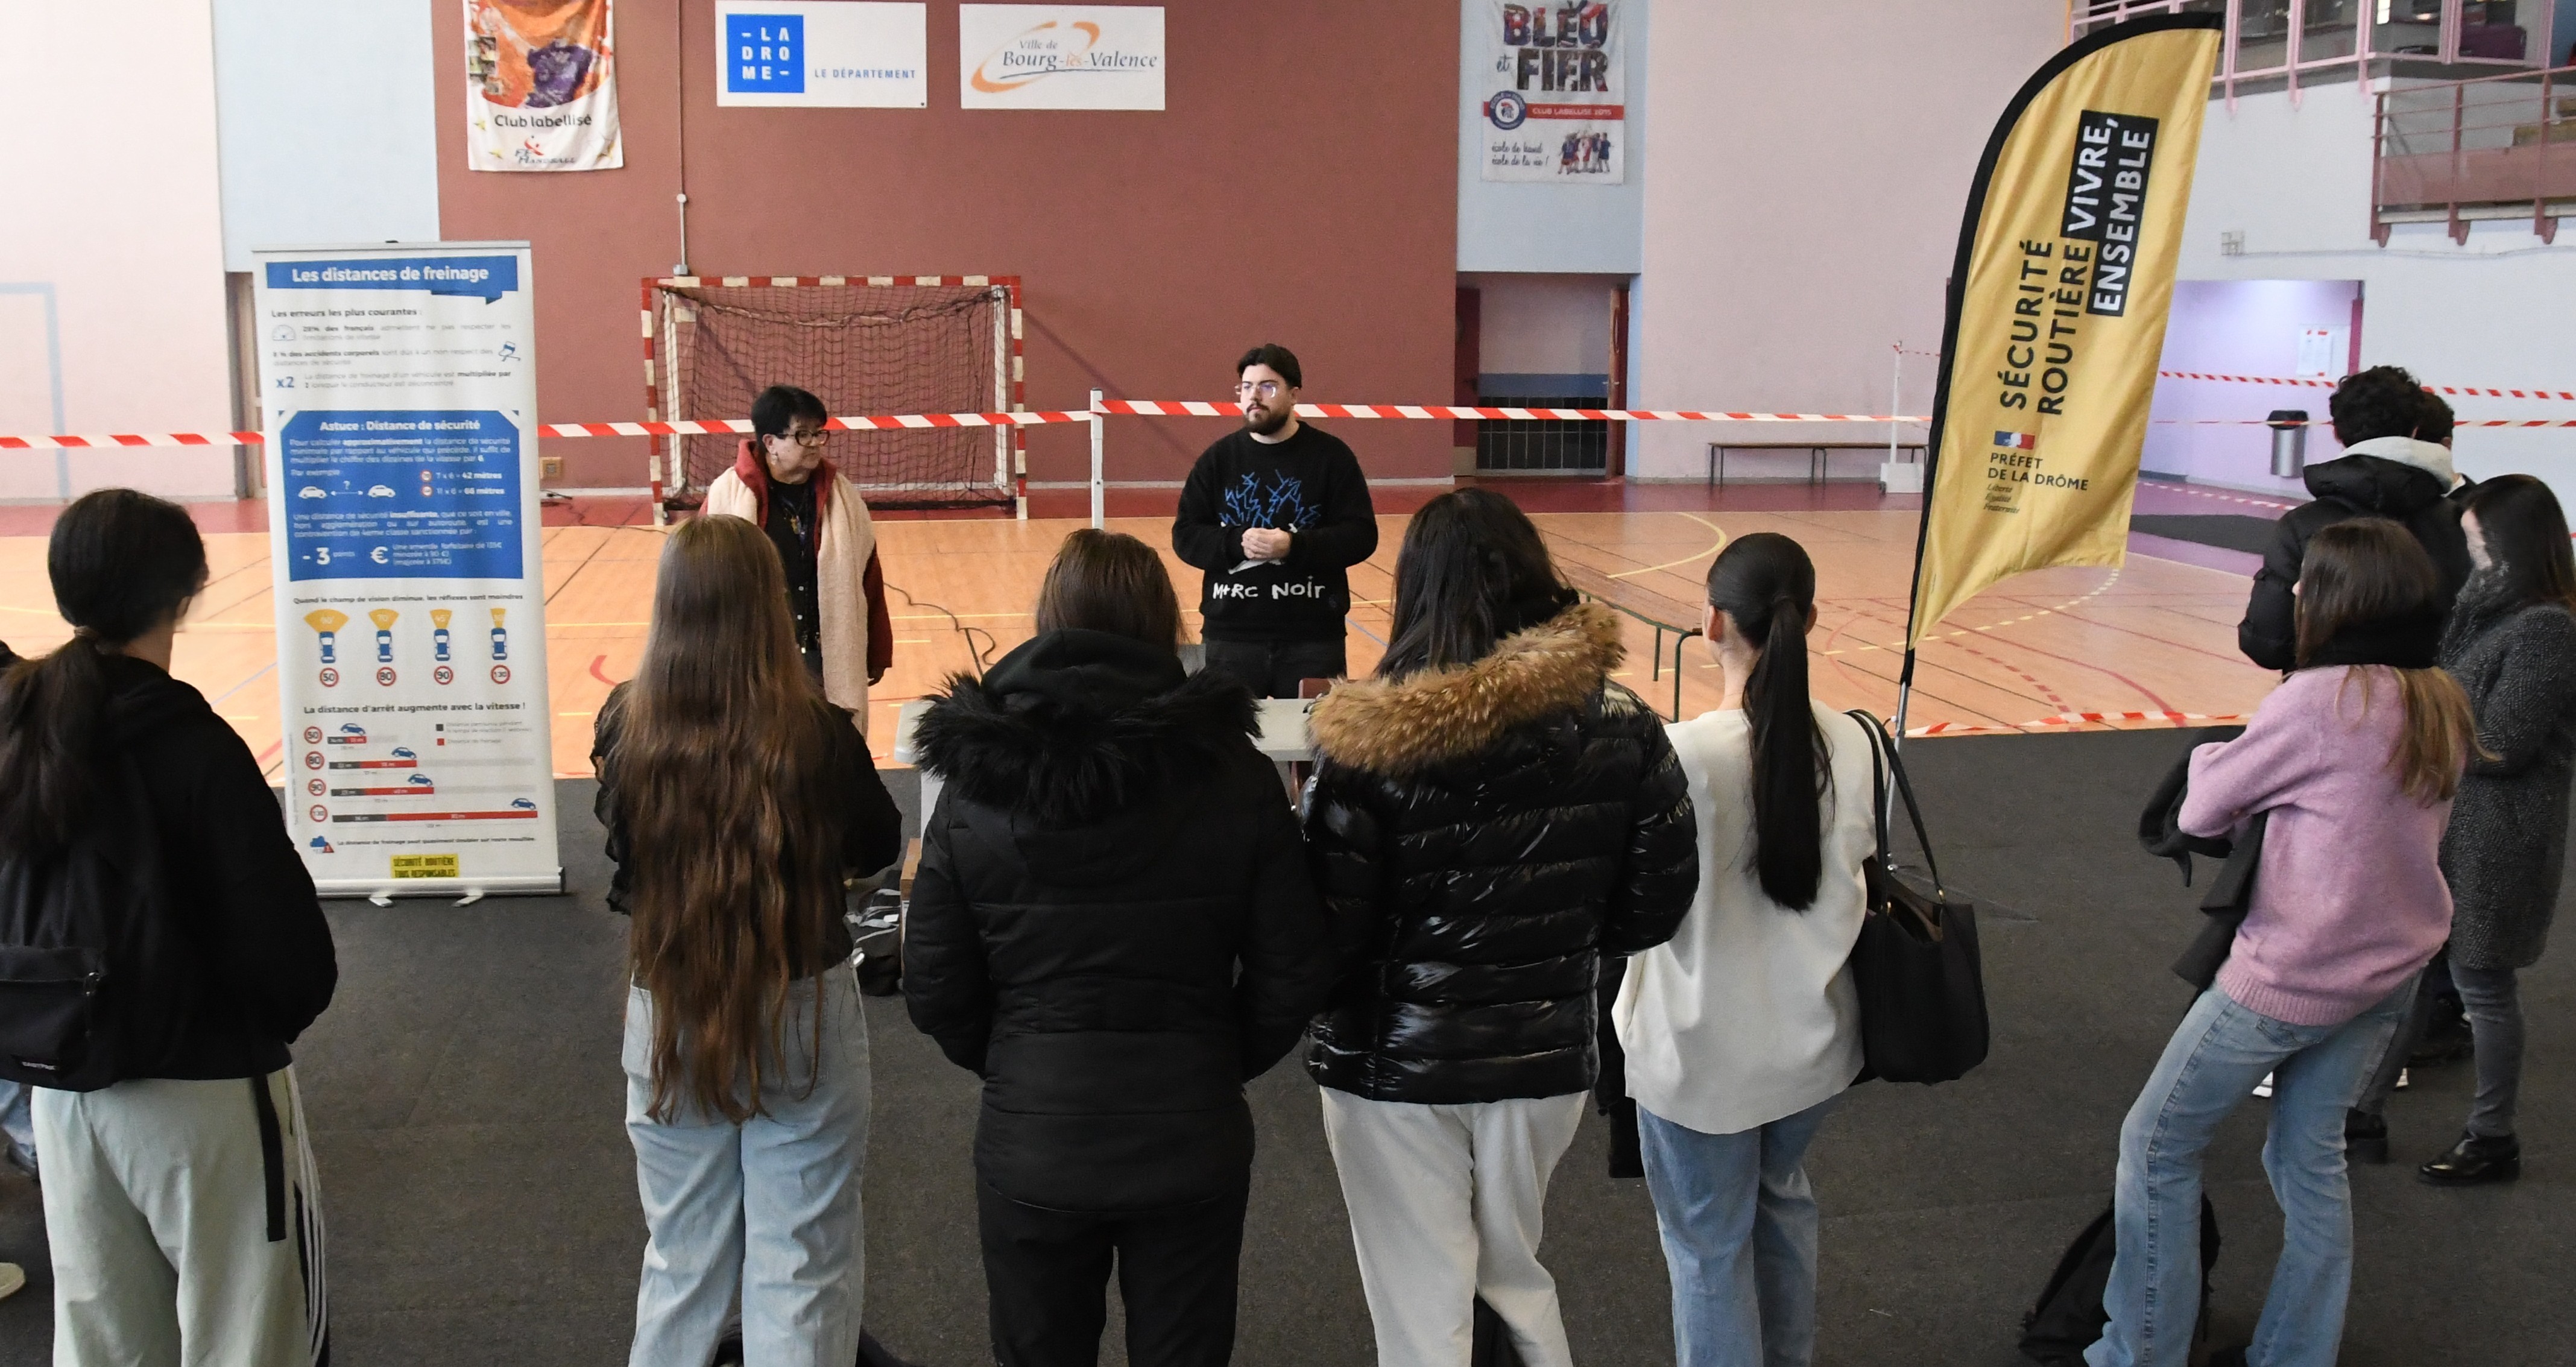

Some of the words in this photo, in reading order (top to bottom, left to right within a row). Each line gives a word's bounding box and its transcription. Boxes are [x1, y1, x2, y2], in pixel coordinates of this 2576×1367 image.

[1504, 4, 1608, 48] BLEU
[1020, 40, 1042, 49] Ville
[1046, 39, 1058, 49] de
[1003, 51, 1157, 71] Bourg-lès-Valence
[815, 69, 827, 78] LE
[833, 66, 915, 78] DÉPARTEMENT
[1497, 54, 1513, 72] et
[1517, 48, 1608, 91] FIER
[494, 115, 528, 127] Club
[531, 113, 592, 127] labellisé
[2093, 129, 2150, 312] ENSEMBLE
[292, 269, 318, 282] Les
[322, 267, 397, 282] distances
[400, 267, 420, 280] de
[423, 266, 489, 282] freinage
[2037, 244, 2091, 415] ROUTIÈRE
[2068, 118, 2119, 233] VIVRE,
[345, 309, 365, 317] plus
[2000, 239, 2053, 410] SÉCURITÉ
[276, 376, 294, 388] x2
[320, 421, 359, 431] Astuce
[366, 420, 416, 431] Distance
[418, 420, 432, 431] de
[434, 419, 481, 430] sécurité
[1990, 452, 2043, 469] PRÉFET
[343, 480, 350, 490] ?
[1987, 467, 2007, 480] DE
[2011, 470, 2029, 482] LA
[2035, 473, 2089, 491] DRÔME
[1987, 483, 2013, 493] Liberté
[316, 547, 331, 565] 3
[370, 546, 389, 564] €
[323, 673, 335, 681] 50
[398, 704, 447, 713] augmente
